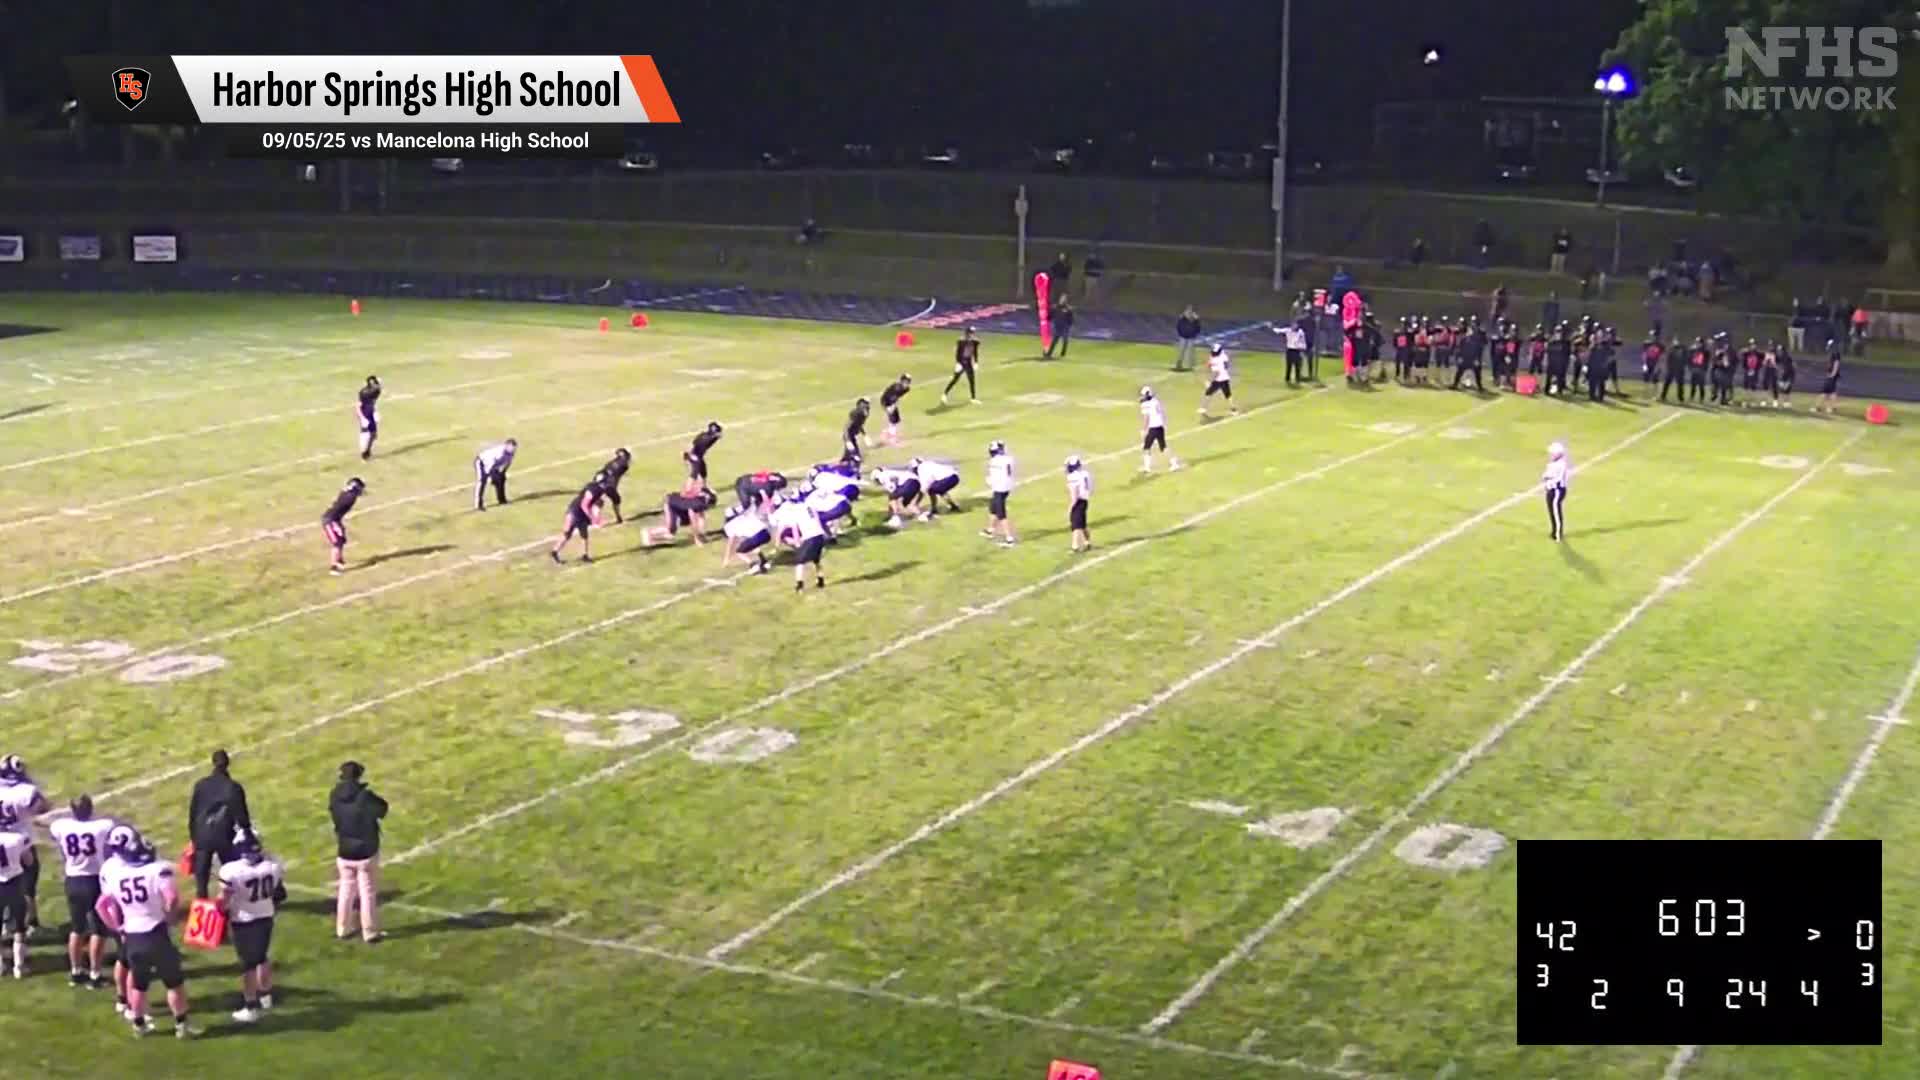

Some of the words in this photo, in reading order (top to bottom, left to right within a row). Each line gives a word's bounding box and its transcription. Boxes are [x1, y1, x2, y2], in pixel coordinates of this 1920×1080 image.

[65, 833, 97, 857] 83
[119, 876, 149, 905] 55
[245, 874, 274, 903] 70
[190, 905, 219, 941] 30
